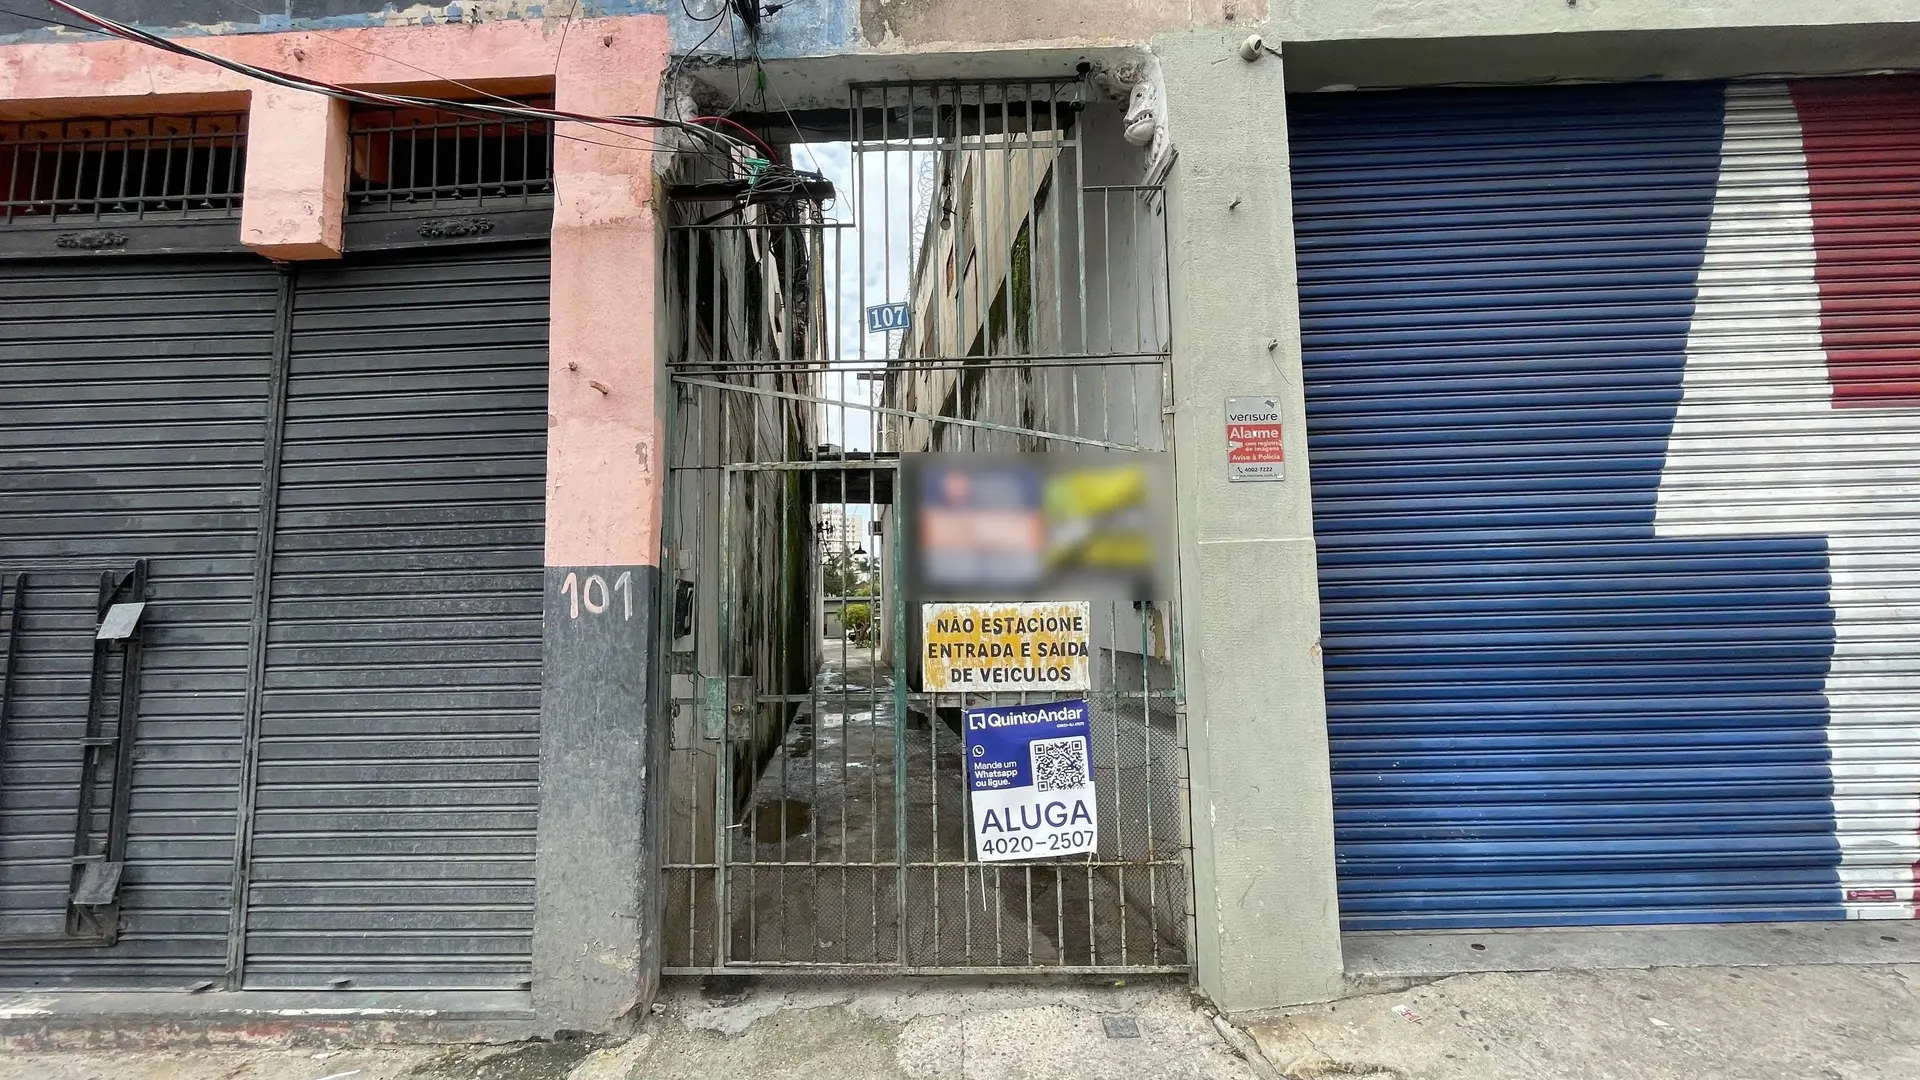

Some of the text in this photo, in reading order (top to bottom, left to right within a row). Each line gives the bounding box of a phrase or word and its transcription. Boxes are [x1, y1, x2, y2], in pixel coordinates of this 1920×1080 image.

[872, 306, 904, 328] 107
[1230, 413, 1278, 421] verisure
[561, 571, 633, 621] 101
[937, 614, 1083, 635] NÃO ESTACIONE
[928, 643, 1014, 659] ENTRADA
[1021, 642, 1031, 657] E
[951, 664, 1071, 683] DE VEÍCULOS
[988, 707, 1083, 727] QuintoAndar
[974, 761, 1017, 770] Mande um
[974, 769, 1018, 778] Whatsapp
[987, 779, 1011, 788] ligue.
[981, 800, 1092, 834] ALUGA
[982, 831, 1094, 854] 4020-2507
